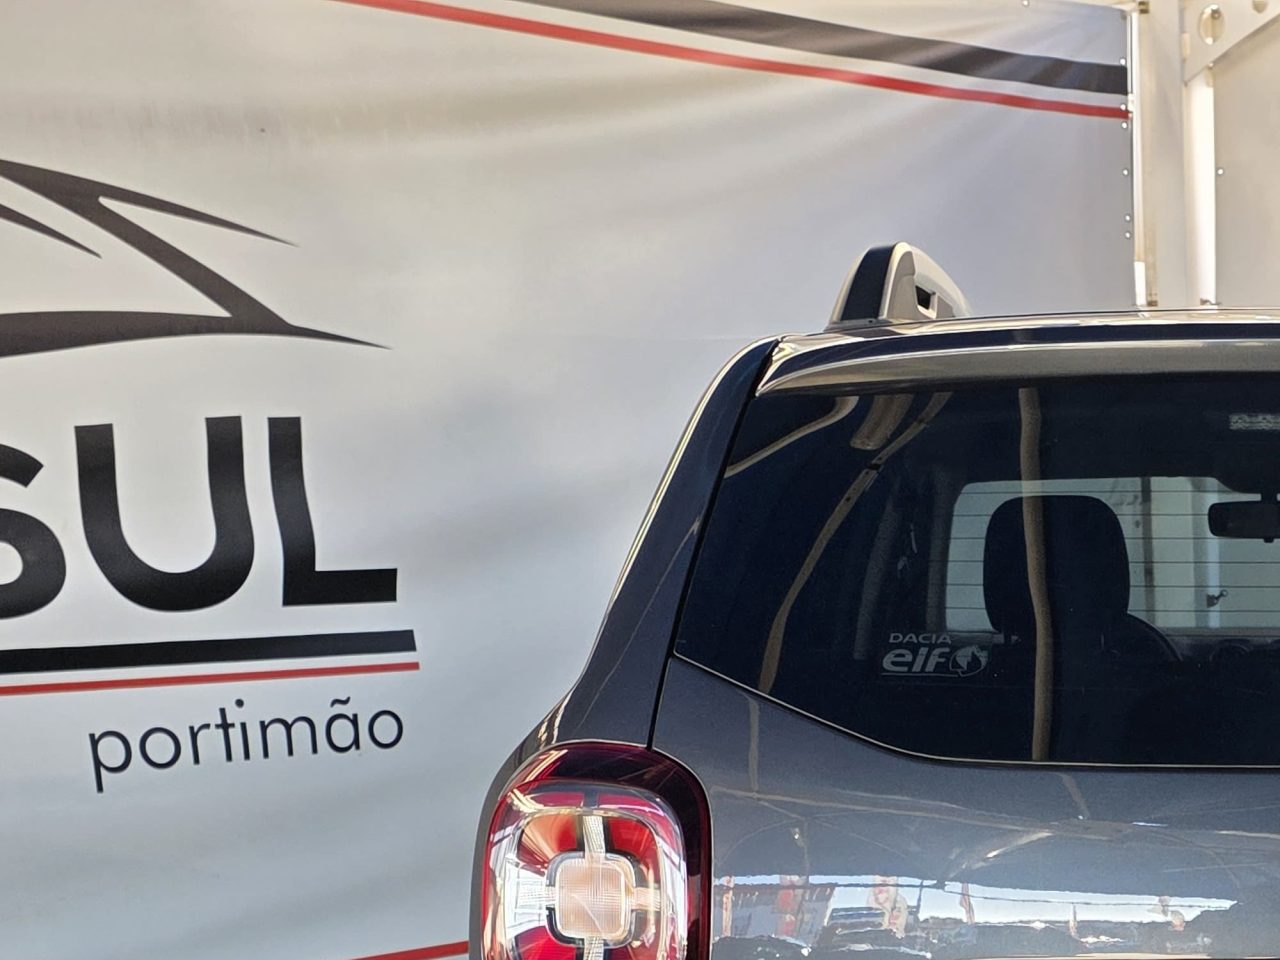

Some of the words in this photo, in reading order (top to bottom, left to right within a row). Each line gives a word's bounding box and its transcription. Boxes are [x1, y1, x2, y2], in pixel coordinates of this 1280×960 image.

[888, 632, 952, 644] DACIA
[882, 646, 950, 673] elf
[89, 696, 404, 794] portimão
